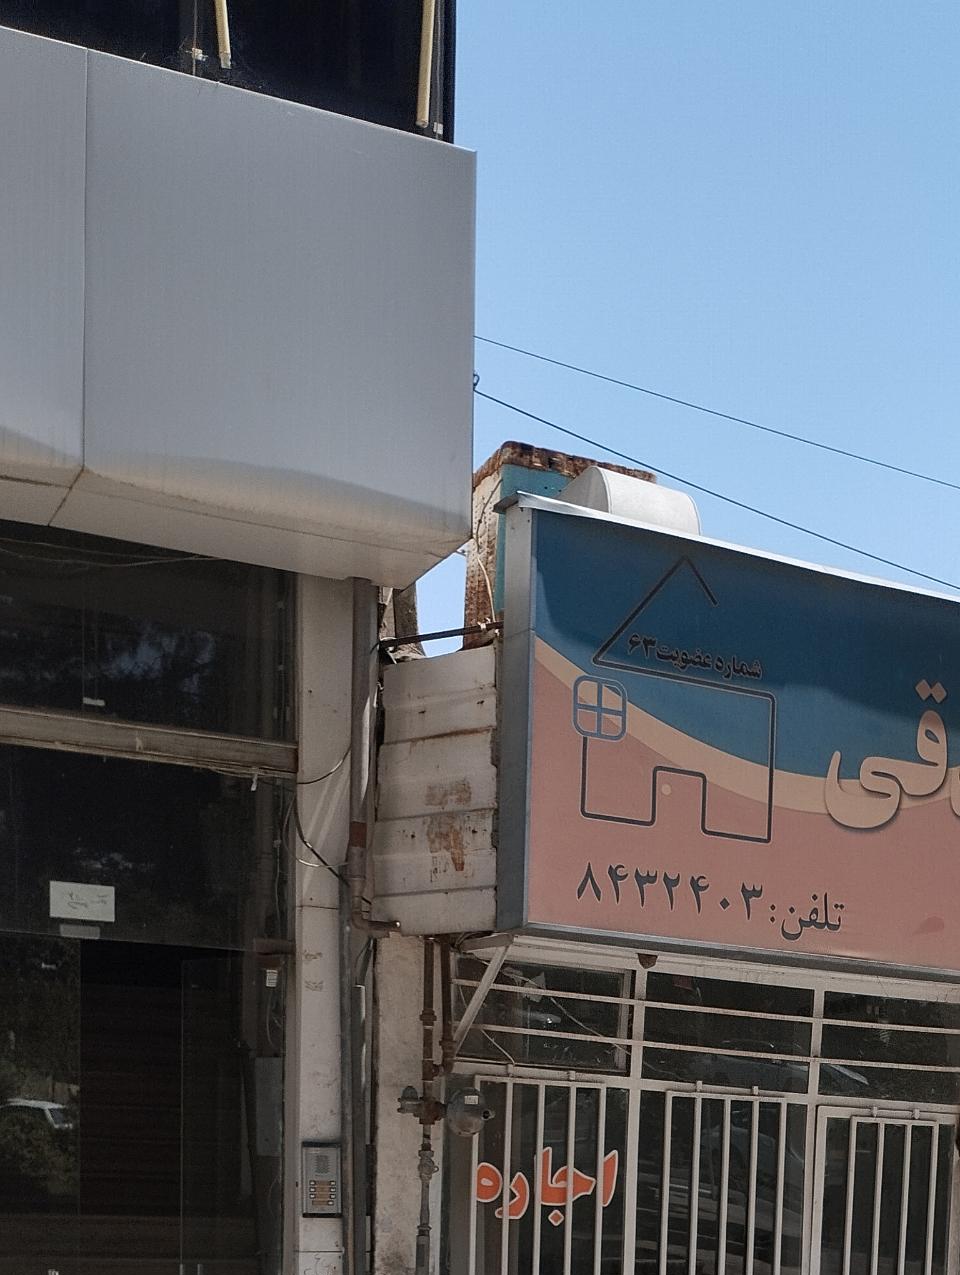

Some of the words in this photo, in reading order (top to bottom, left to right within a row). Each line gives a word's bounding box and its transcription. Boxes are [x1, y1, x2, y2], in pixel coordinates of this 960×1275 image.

[656, 645, 713, 672] عضویت
[713, 654, 763, 680] شماره
[576, 860, 764, 922] ۸۴۳۲۴۰۳
[476, 1146, 620, 1227] اجاره
